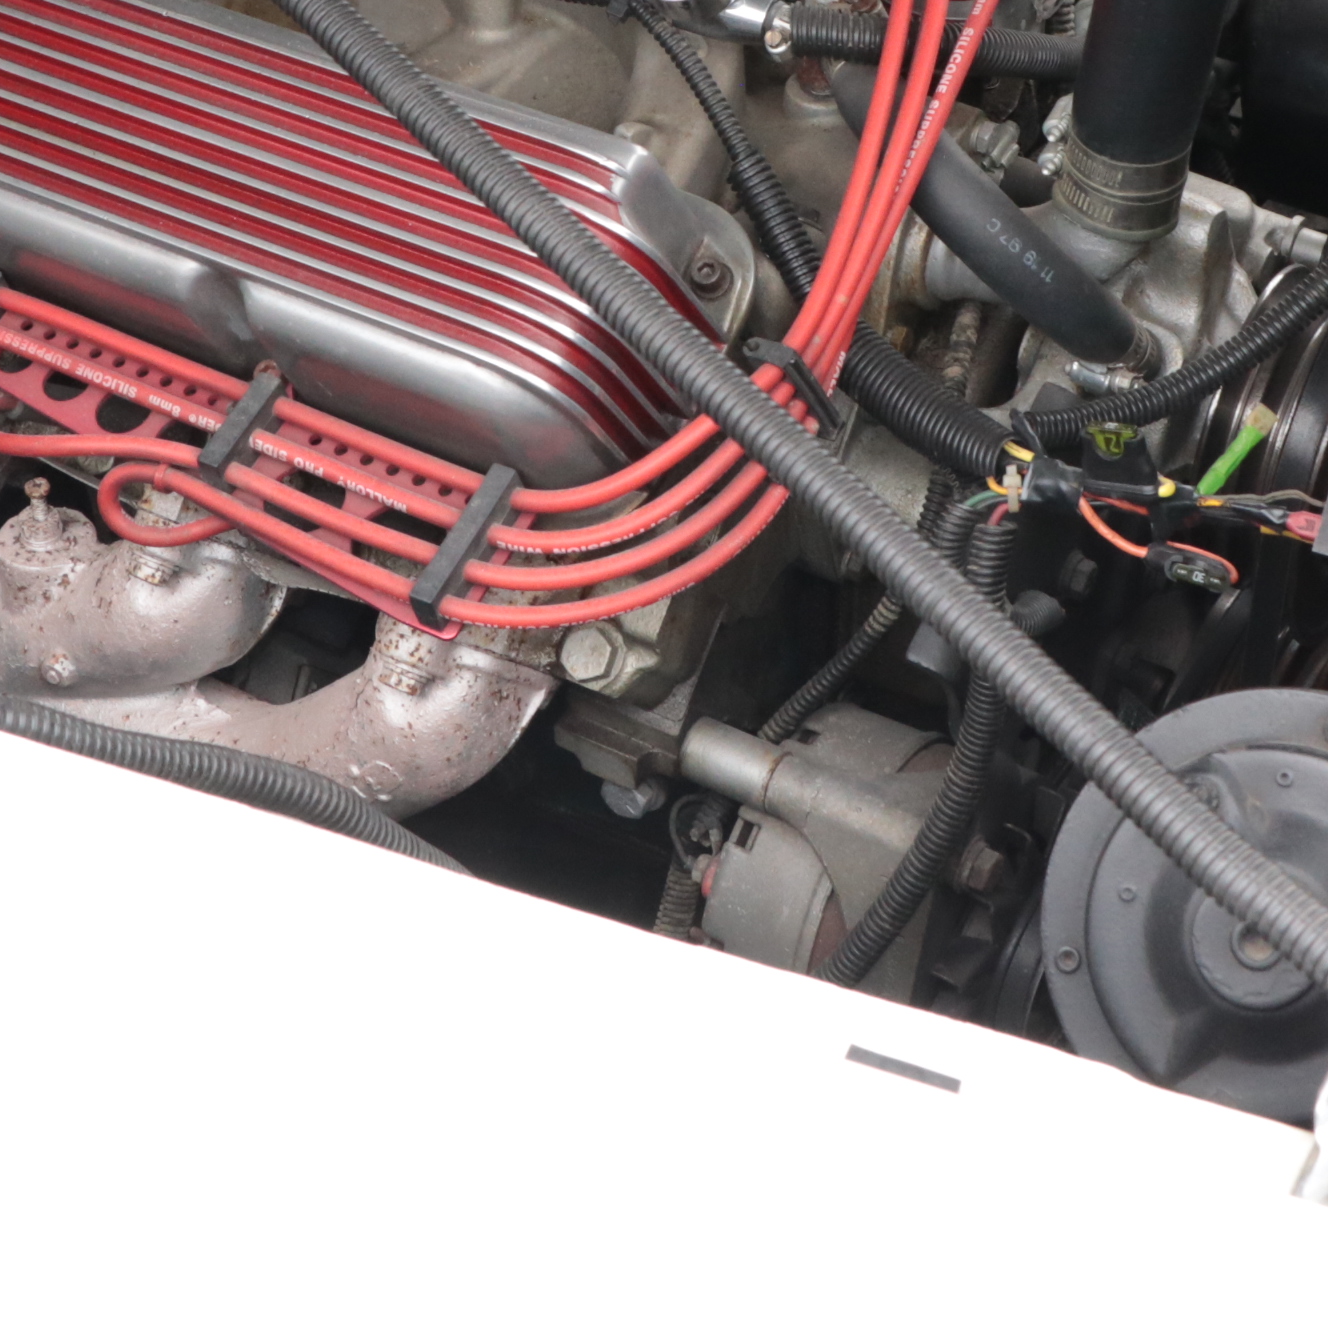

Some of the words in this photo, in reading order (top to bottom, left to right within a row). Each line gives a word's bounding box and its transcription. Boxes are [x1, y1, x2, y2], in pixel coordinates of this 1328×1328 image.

[935, 27, 974, 94] SILICONE
[1040, 266, 1055, 283] 11
[75, 363, 138, 399] SILICONE
[149, 394, 181, 418] 8mm
[293, 456, 324, 478] PRO
[336, 475, 408, 514] MALLORY
